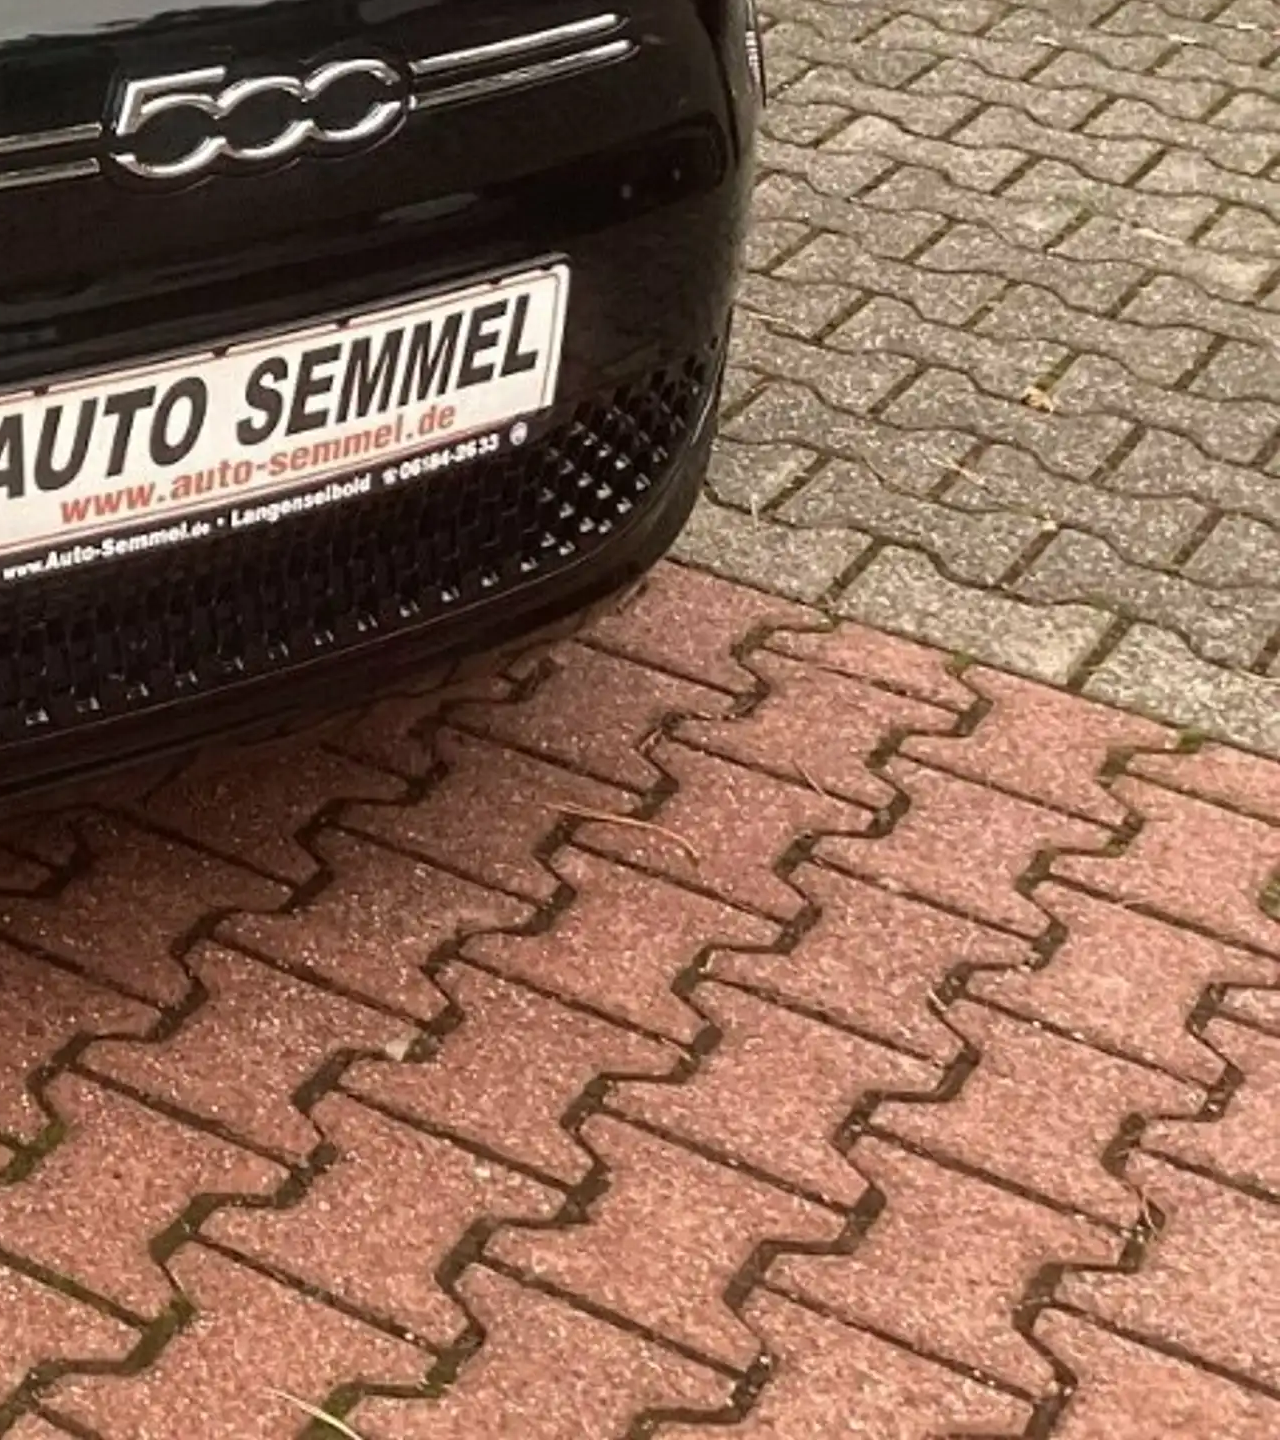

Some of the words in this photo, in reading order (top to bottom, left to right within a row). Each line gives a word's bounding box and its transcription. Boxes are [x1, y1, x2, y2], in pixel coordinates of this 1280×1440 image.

[110, 58, 403, 178] 500
[235, 293, 540, 447] SEMMEL
[60, 403, 456, 523] www.auto-semmel.de
[2, 520, 210, 581] www.Auto-Semmel.de
[230, 472, 372, 527] Langenselbold
